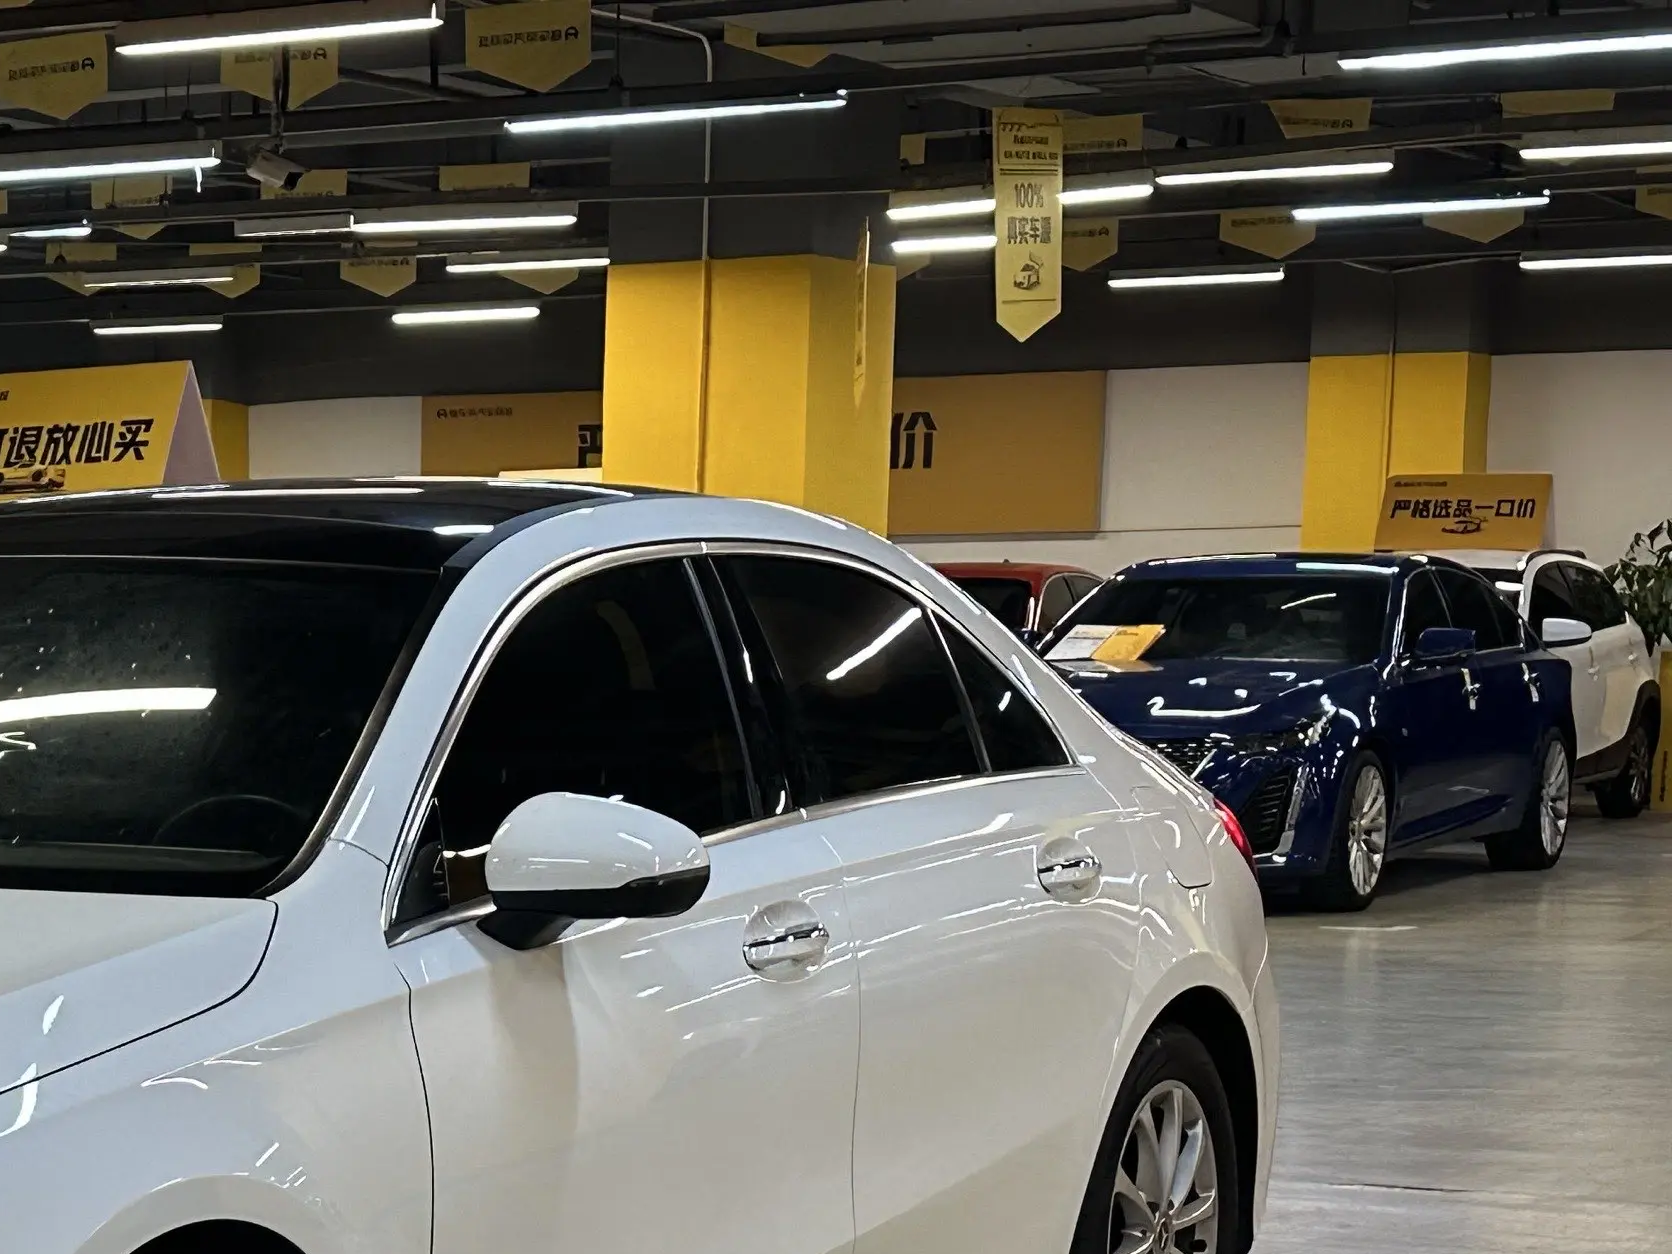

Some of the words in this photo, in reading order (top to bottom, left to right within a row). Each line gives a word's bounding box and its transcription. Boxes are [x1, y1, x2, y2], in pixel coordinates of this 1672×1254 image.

[1014, 182, 1044, 208] 100%
[1390, 498, 1536, 519] 严格选品一口价
